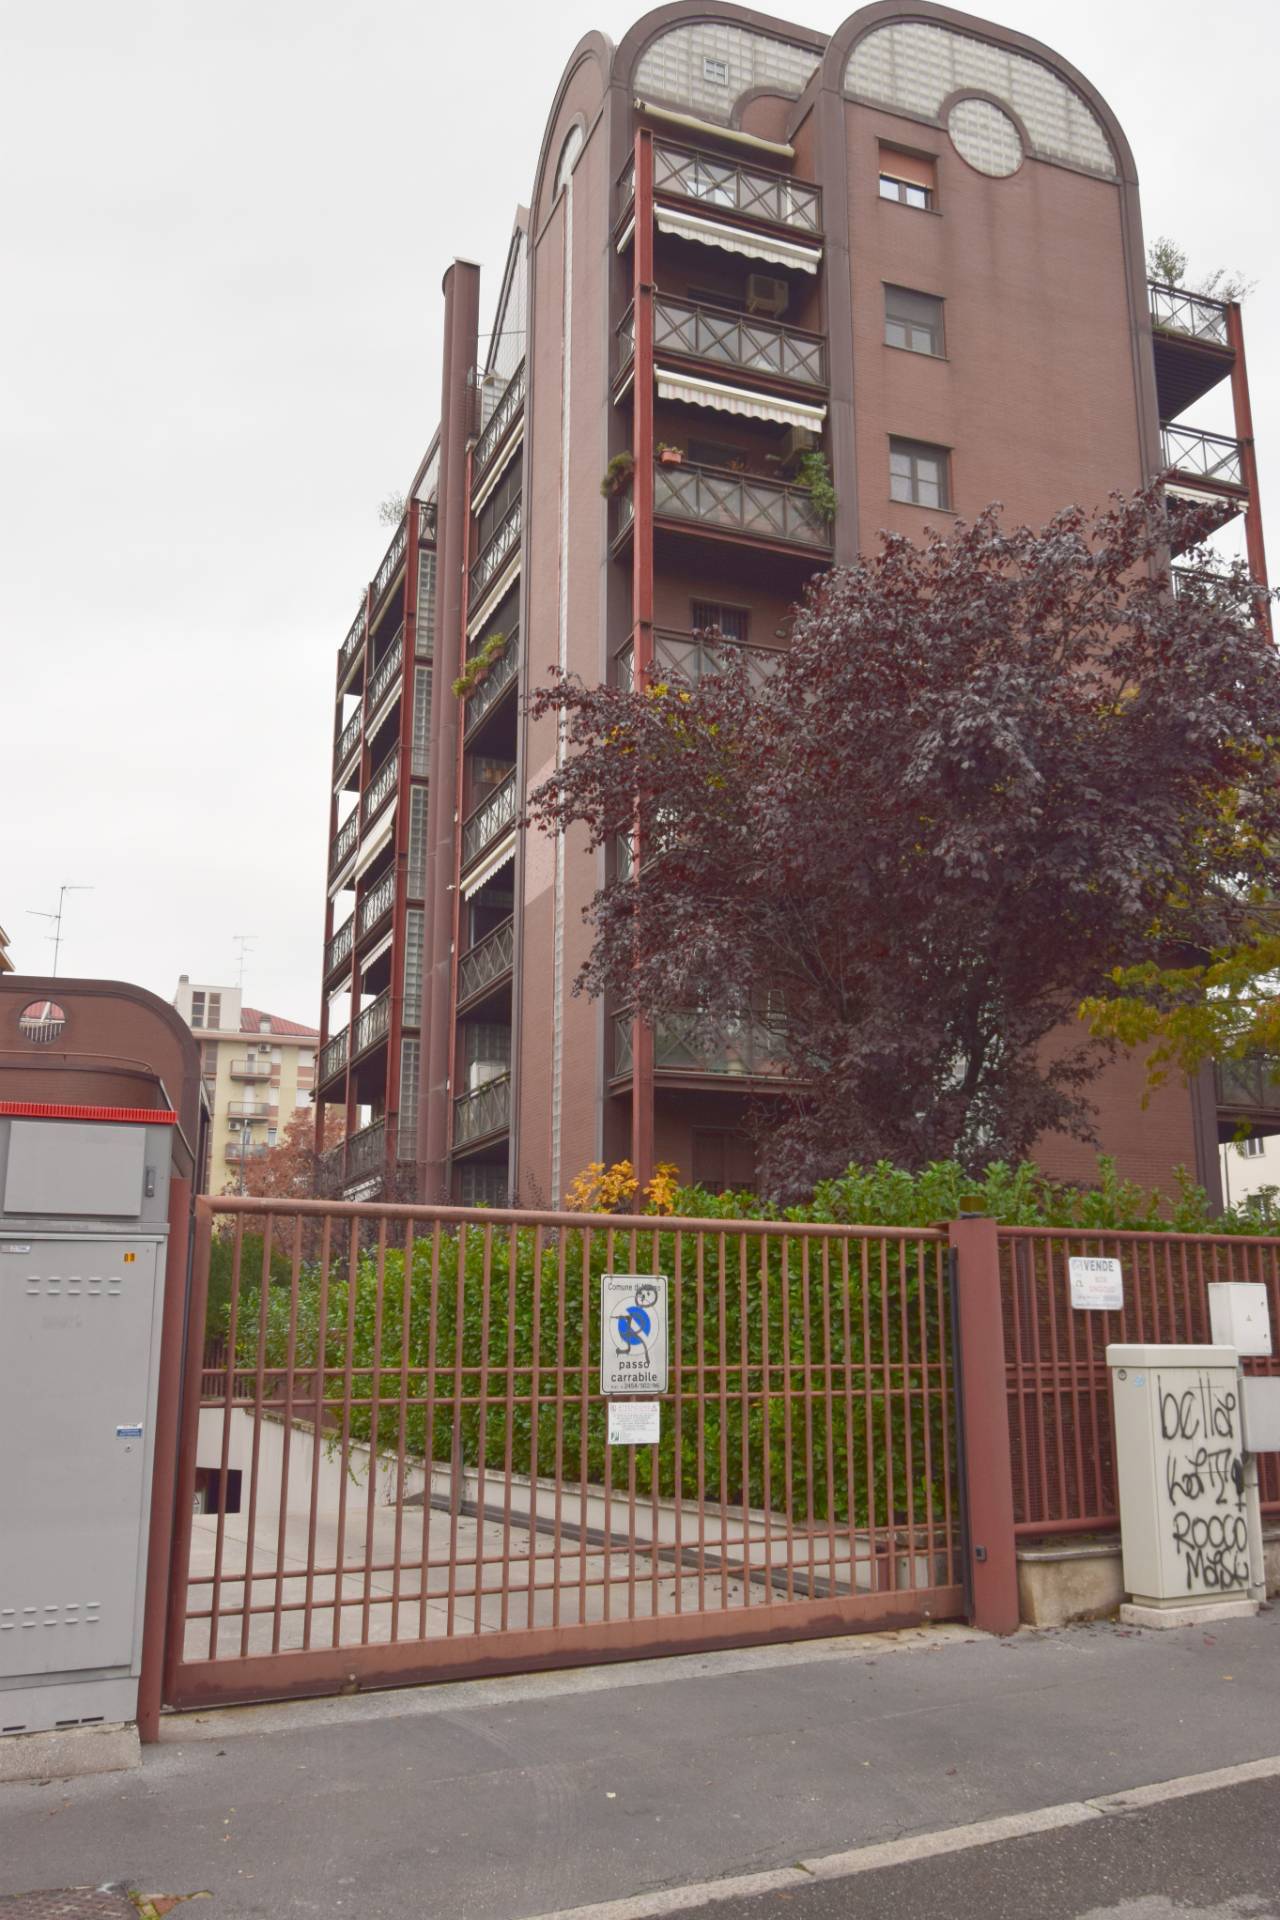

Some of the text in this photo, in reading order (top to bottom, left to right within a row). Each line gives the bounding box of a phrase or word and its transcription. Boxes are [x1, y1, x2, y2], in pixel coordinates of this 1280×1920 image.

[1083, 1260, 1114, 1272] VENDE
[608, 1282, 633, 1291] Comune
[618, 1361, 650, 1370] passo
[611, 1372, 657, 1382] carrabile
